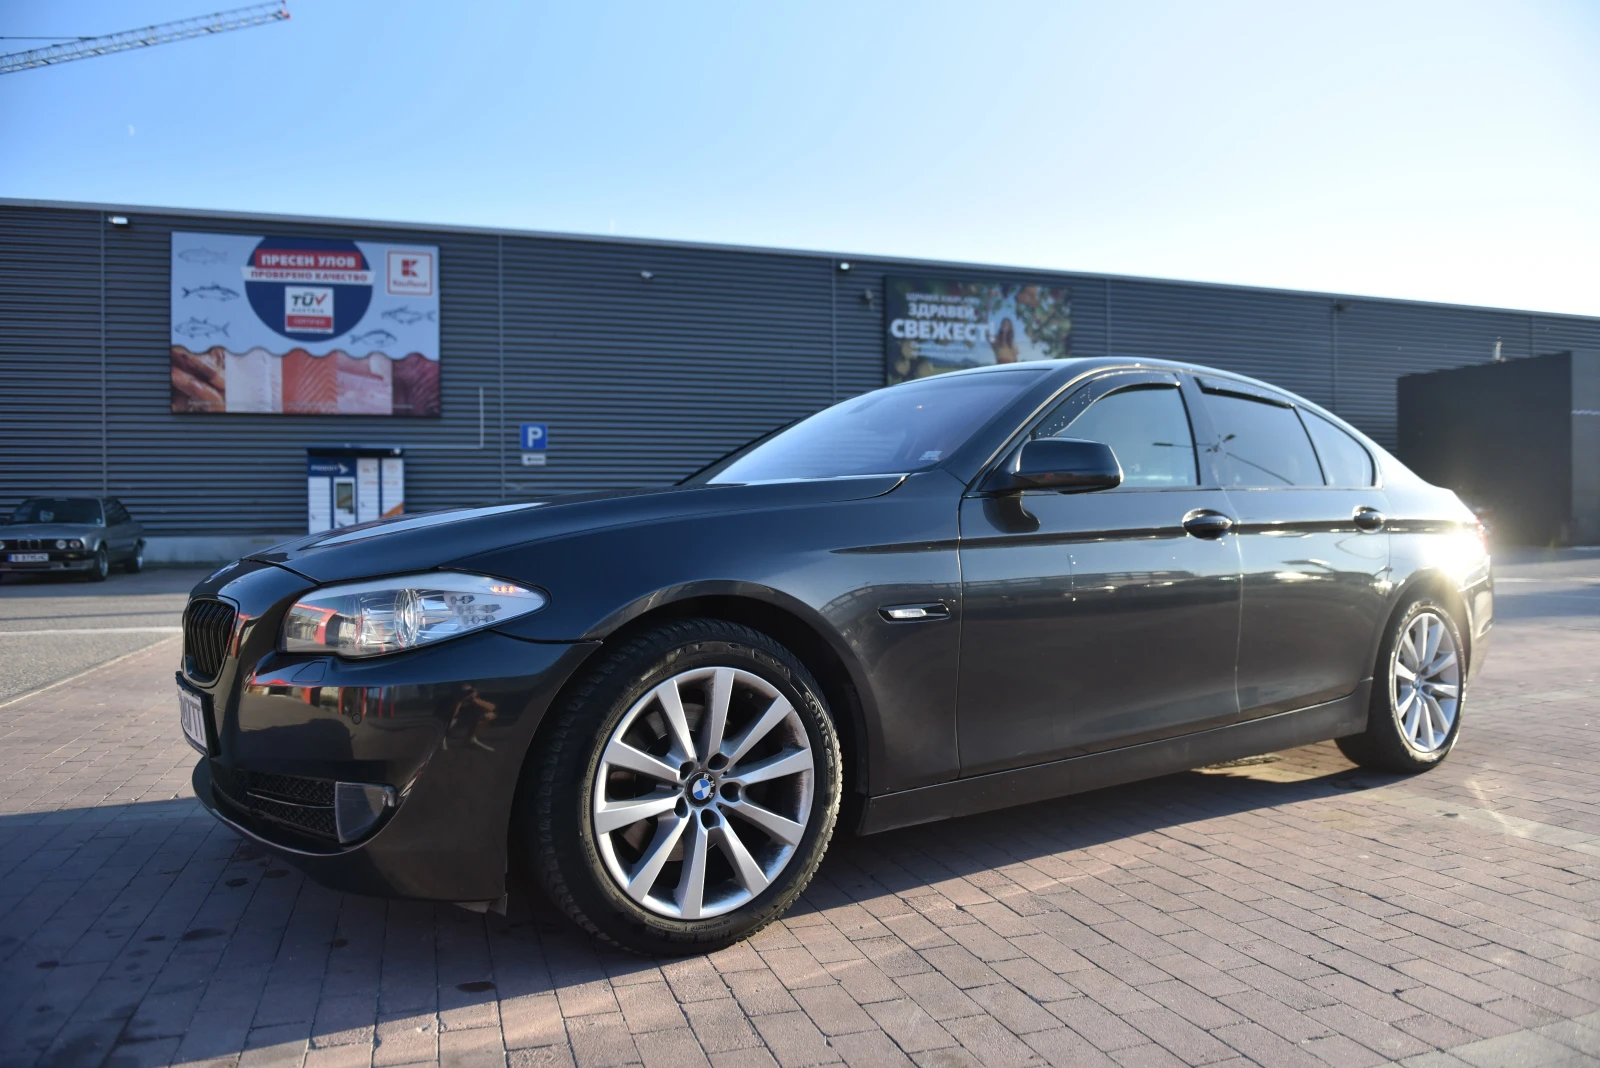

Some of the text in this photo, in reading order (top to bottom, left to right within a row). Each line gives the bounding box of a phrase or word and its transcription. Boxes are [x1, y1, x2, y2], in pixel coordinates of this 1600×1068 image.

[261, 254, 356, 268] ПРЕСЕН УЛОВ
[251, 270, 368, 282] ПРОВЕРЕНО КАЧЕСТВО
[890, 319, 996, 342] СВЕЖЕСТ!
[527, 426, 543, 448] P
[703, 773, 716, 799] BMW
